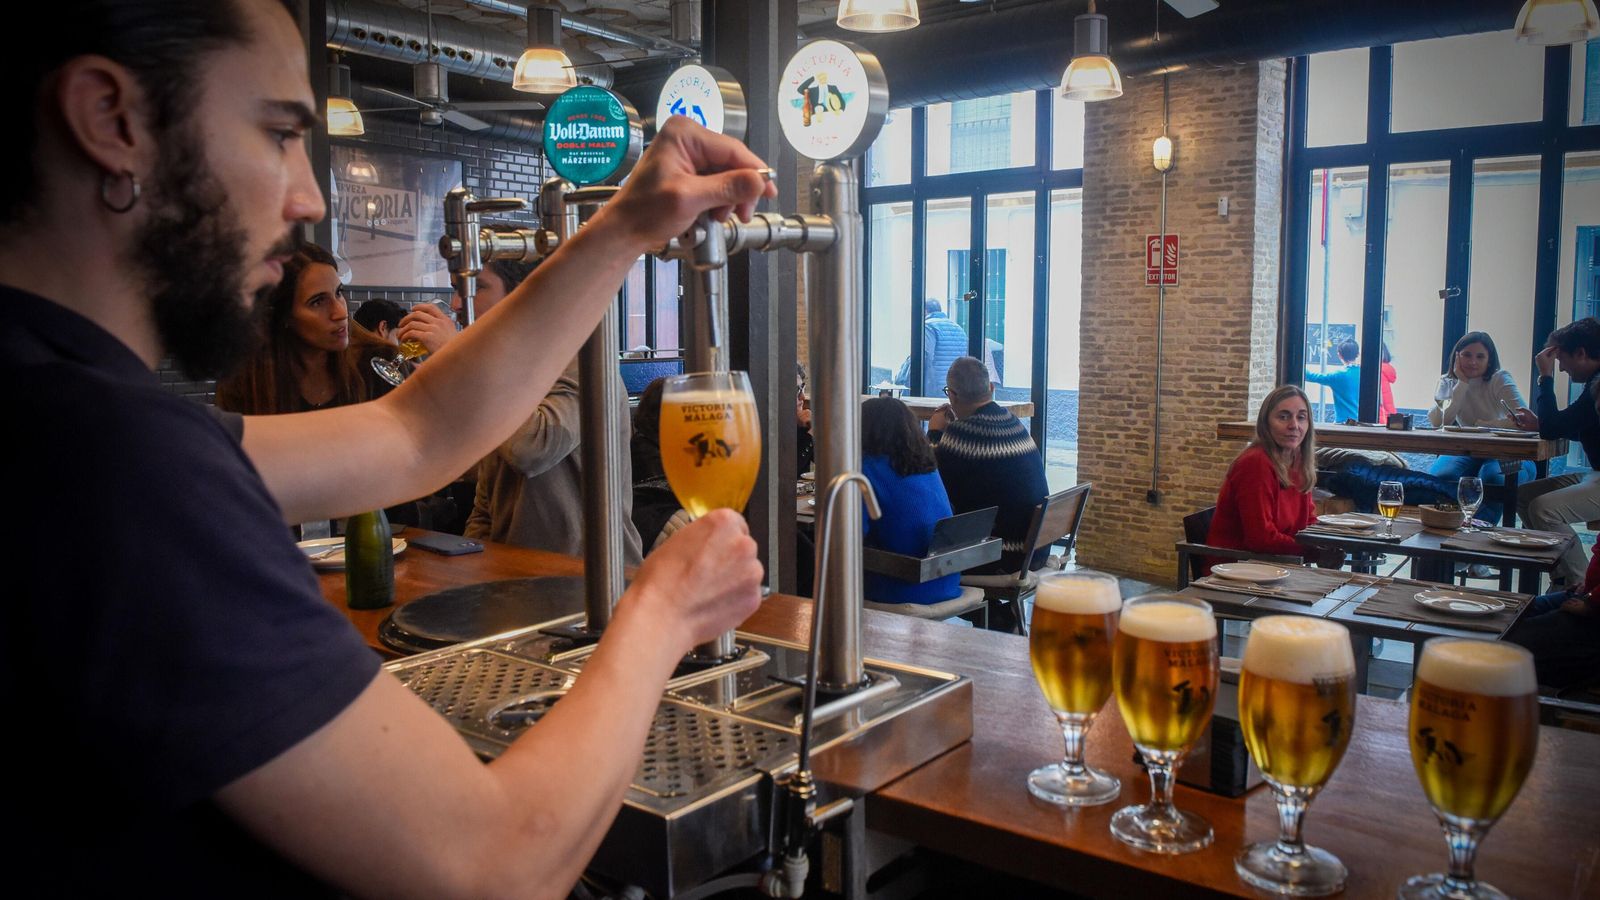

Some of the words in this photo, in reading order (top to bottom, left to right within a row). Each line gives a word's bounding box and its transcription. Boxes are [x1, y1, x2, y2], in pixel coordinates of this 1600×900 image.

[791, 54, 851, 84] VICTORIA
[666, 76, 711, 106] VICTORIA
[549, 123, 624, 140] Voll-Damm
[681, 403, 733, 413] VICTORIA
